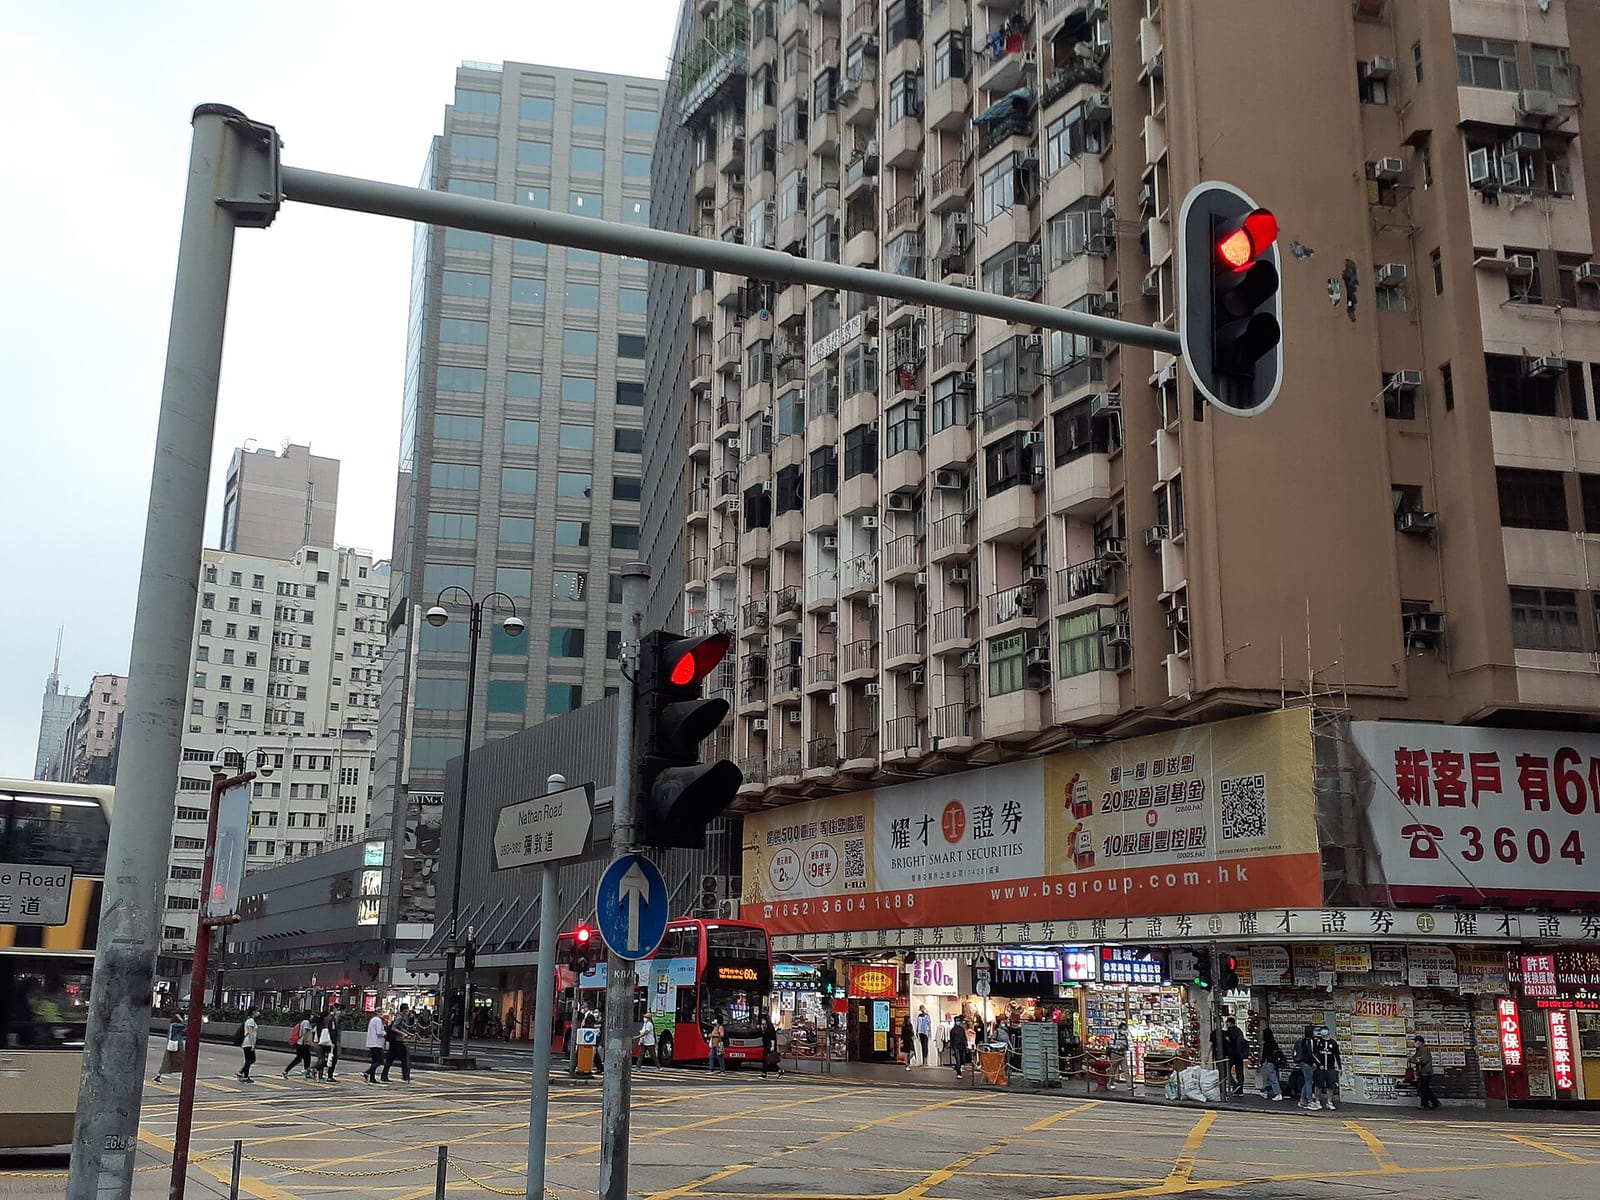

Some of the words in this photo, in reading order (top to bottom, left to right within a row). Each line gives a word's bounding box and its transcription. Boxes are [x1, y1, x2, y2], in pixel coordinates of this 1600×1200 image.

[1152, 753, 1195, 777] 即送您
[1393, 746, 1503, 809] 新客戶
[1101, 778, 1205, 814] 20股盈富基金
[518, 808, 542, 827] Nathan
[543, 802, 563, 820] Road
[891, 814, 935, 850] 耀才
[972, 800, 1023, 840] 證券
[523, 830, 554, 856] 彌敦道
[891, 855, 926, 870] BRIGHT
[929, 851, 963, 866] SMART
[967, 842, 1023, 861] SECURITIES
[1103, 826, 1207, 857] 10股匯豐控股
[1459, 825, 1586, 866] 3604
[18, 871, 67, 888] Road
[991, 864, 1248, 899] www.bsgroup.com.hk
[776, 901, 816, 917] (852)
[822, 897, 866, 913] 3604
[875, 892, 916, 911] 1888
[1091, 914, 1193, 940] 耀才證券
[1238, 910, 1395, 934] 耀才證券
[1453, 911, 1600, 940] 耀才證券
[1526, 957, 1549, 971] 許氏
[1356, 1000, 1398, 1017] 23113878
[1500, 999, 1521, 1066] 信心保證
[1551, 1012, 1573, 1089] 許氏匯款中心
